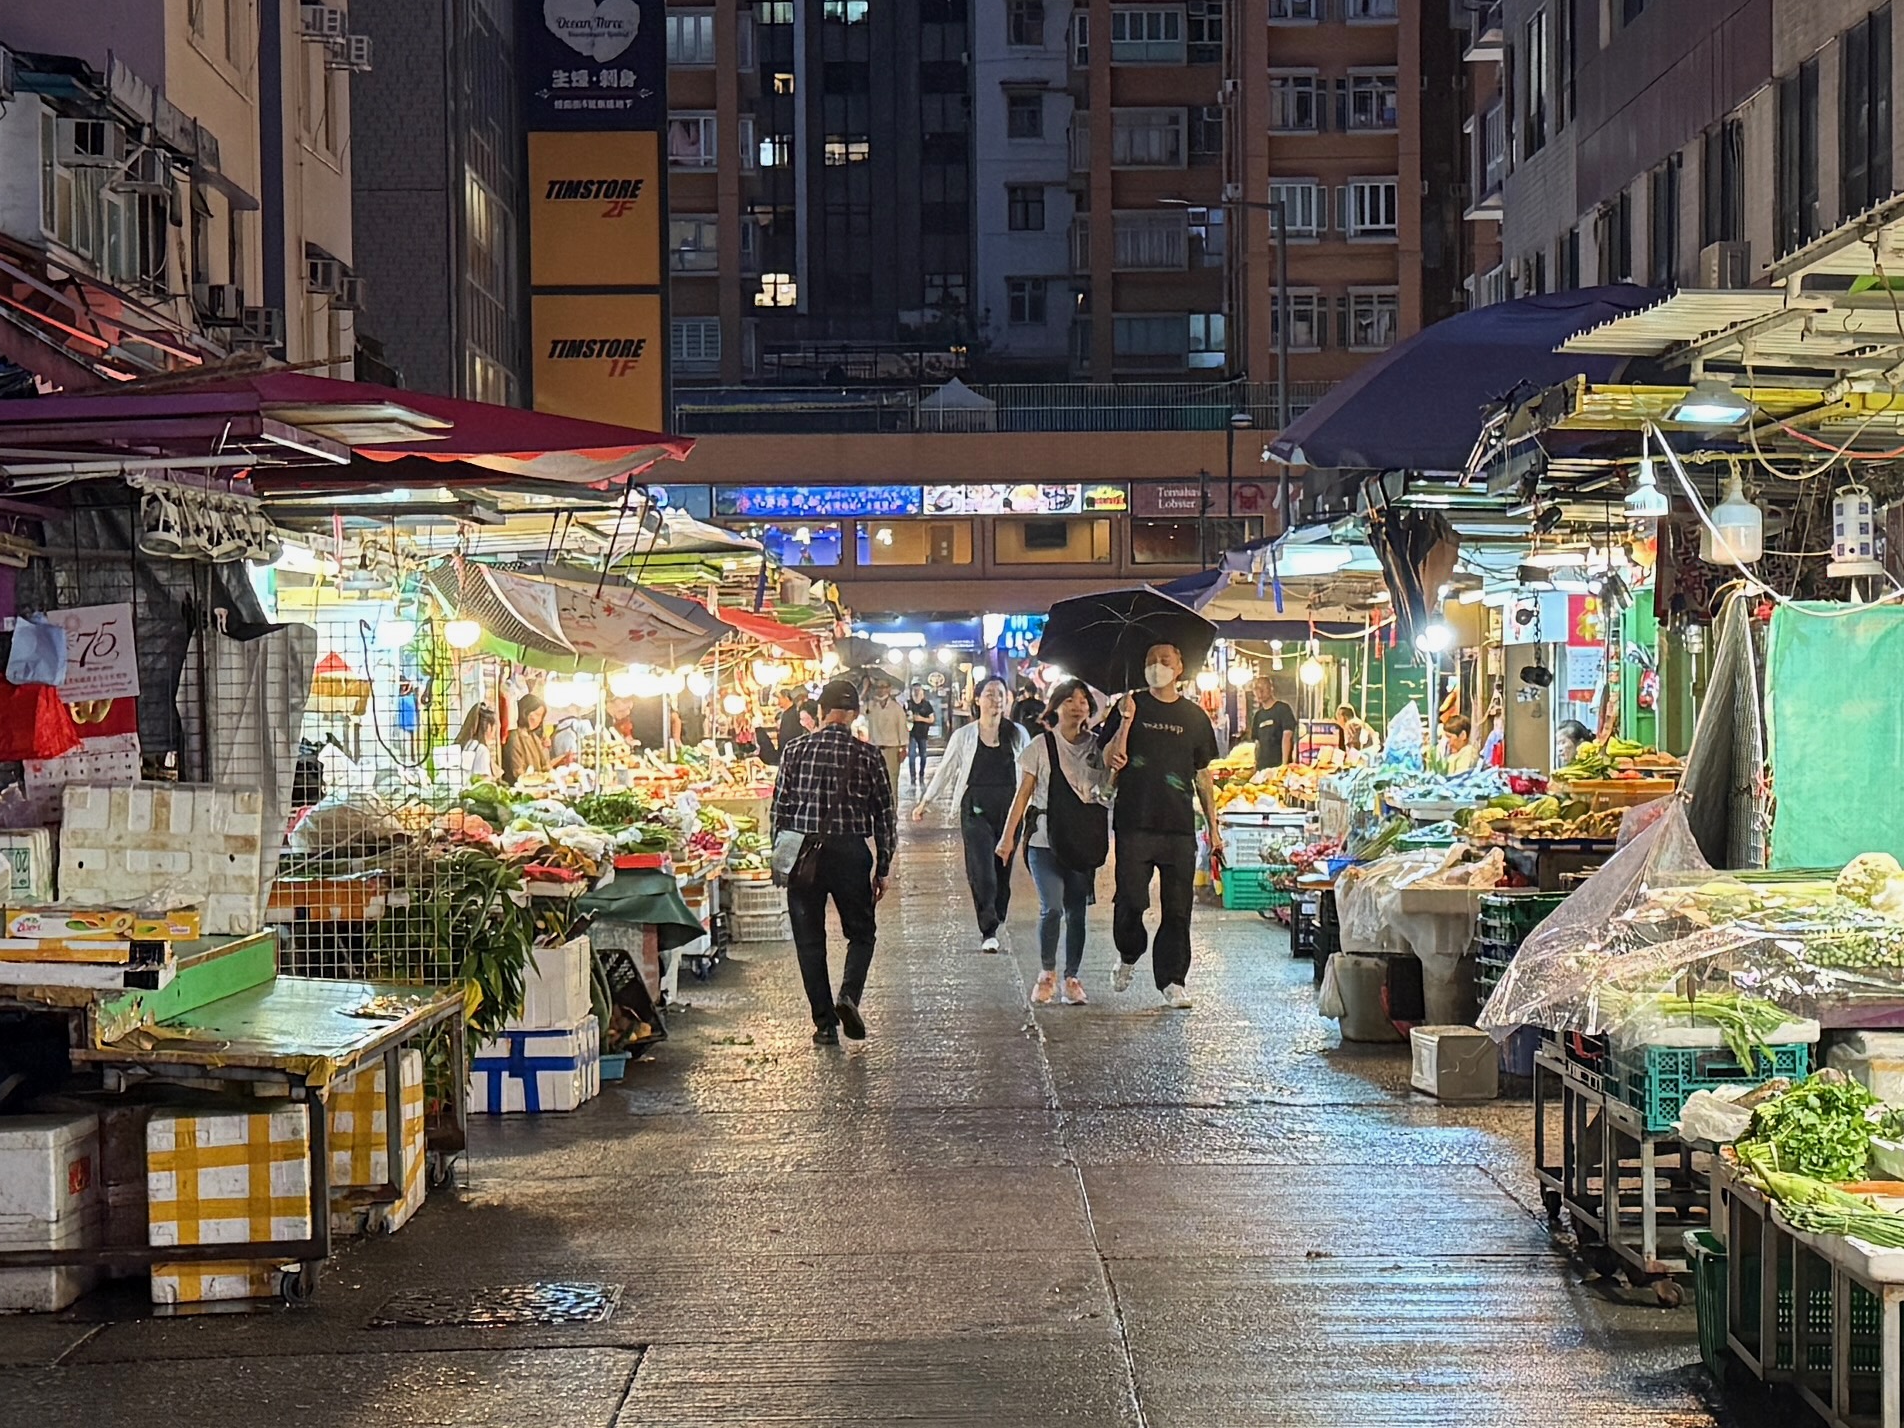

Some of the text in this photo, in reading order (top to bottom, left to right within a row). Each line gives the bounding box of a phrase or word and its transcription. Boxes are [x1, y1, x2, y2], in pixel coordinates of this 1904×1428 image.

[556, 17, 624, 30] Ocean Three
[545, 179, 644, 200] TIMSTORE
[601, 200, 637, 218] 2F
[548, 339, 646, 359] TIMSTORE
[608, 360, 638, 377] 1F
[76, 618, 117, 668] 75
